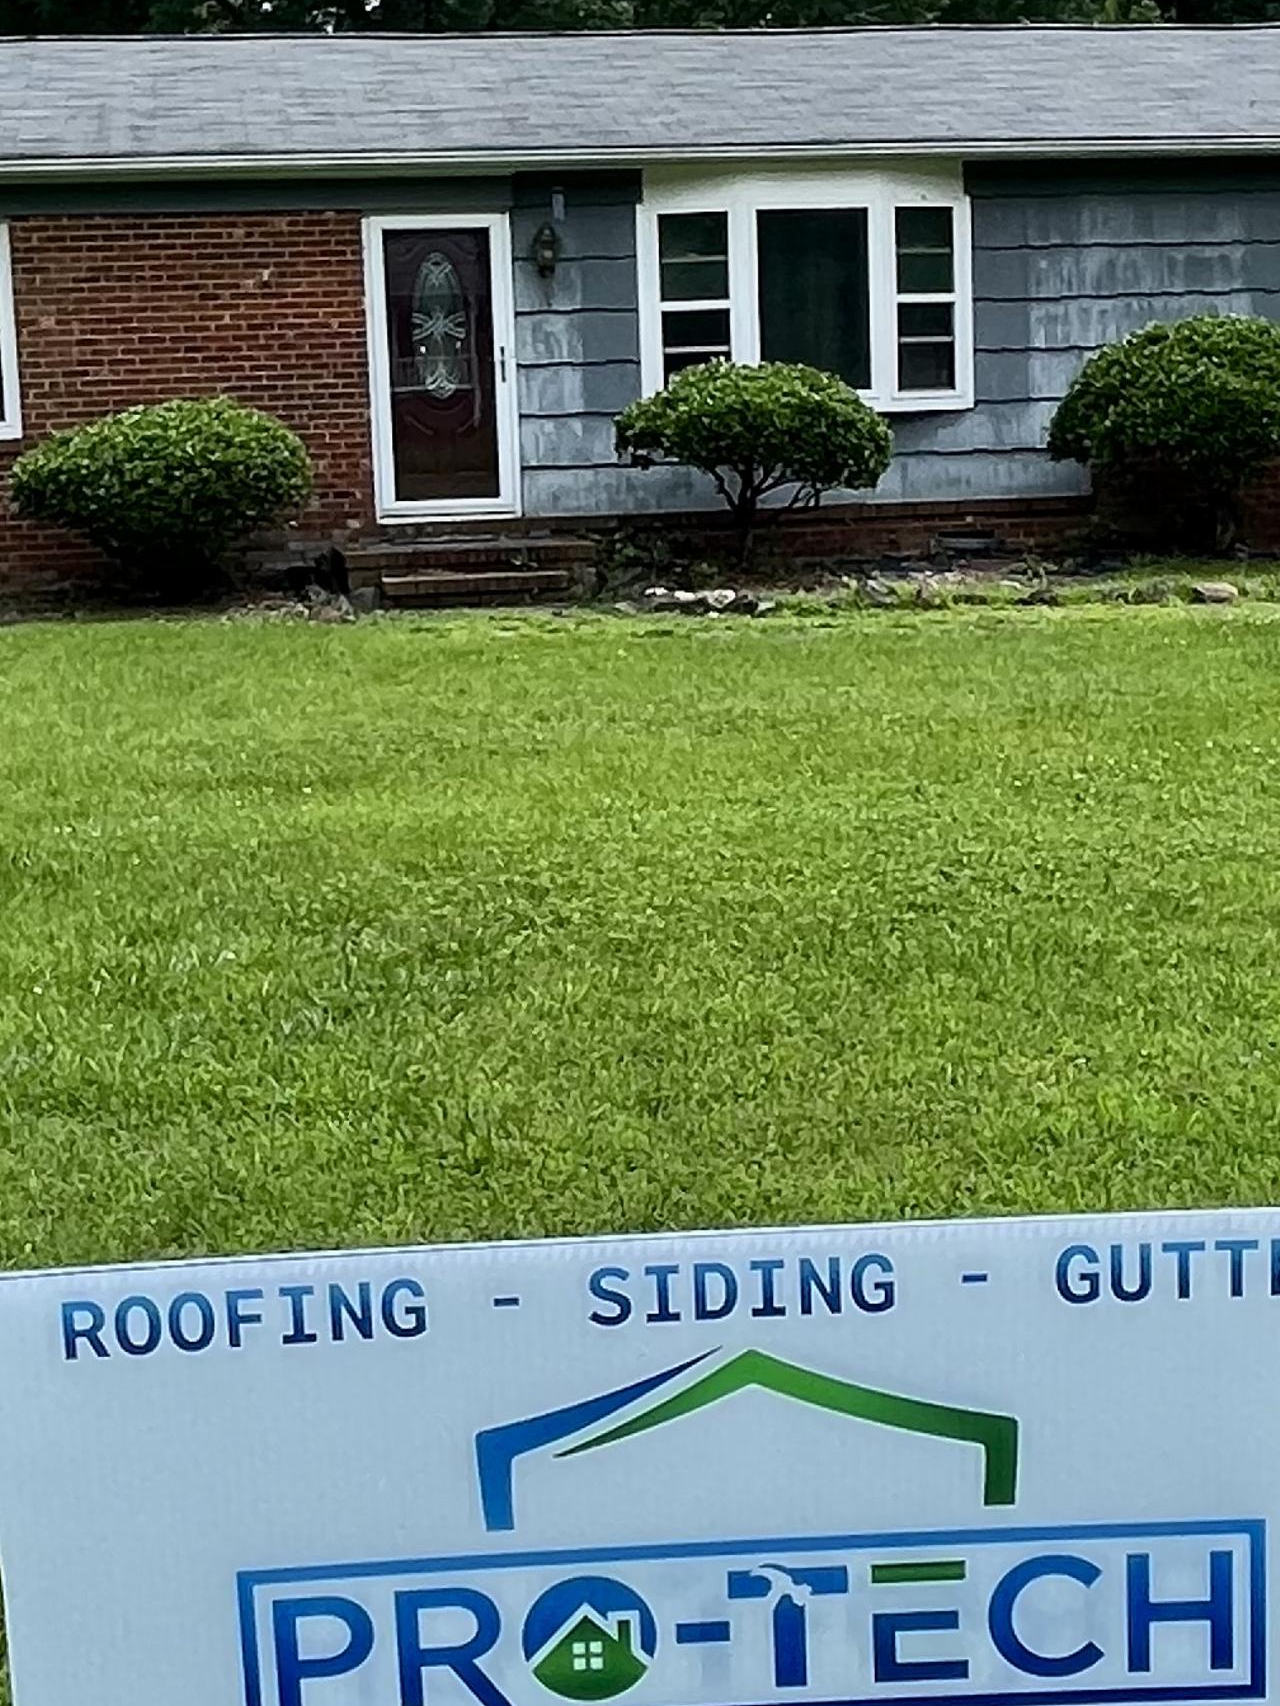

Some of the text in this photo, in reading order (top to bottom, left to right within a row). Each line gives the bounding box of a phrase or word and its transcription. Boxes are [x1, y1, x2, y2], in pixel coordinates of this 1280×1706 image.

[61, 1277, 428, 1360] ROOFING
[493, 1296, 521, 1308] -
[588, 1251, 897, 1327] SIDING
[961, 1273, 989, 1284] -
